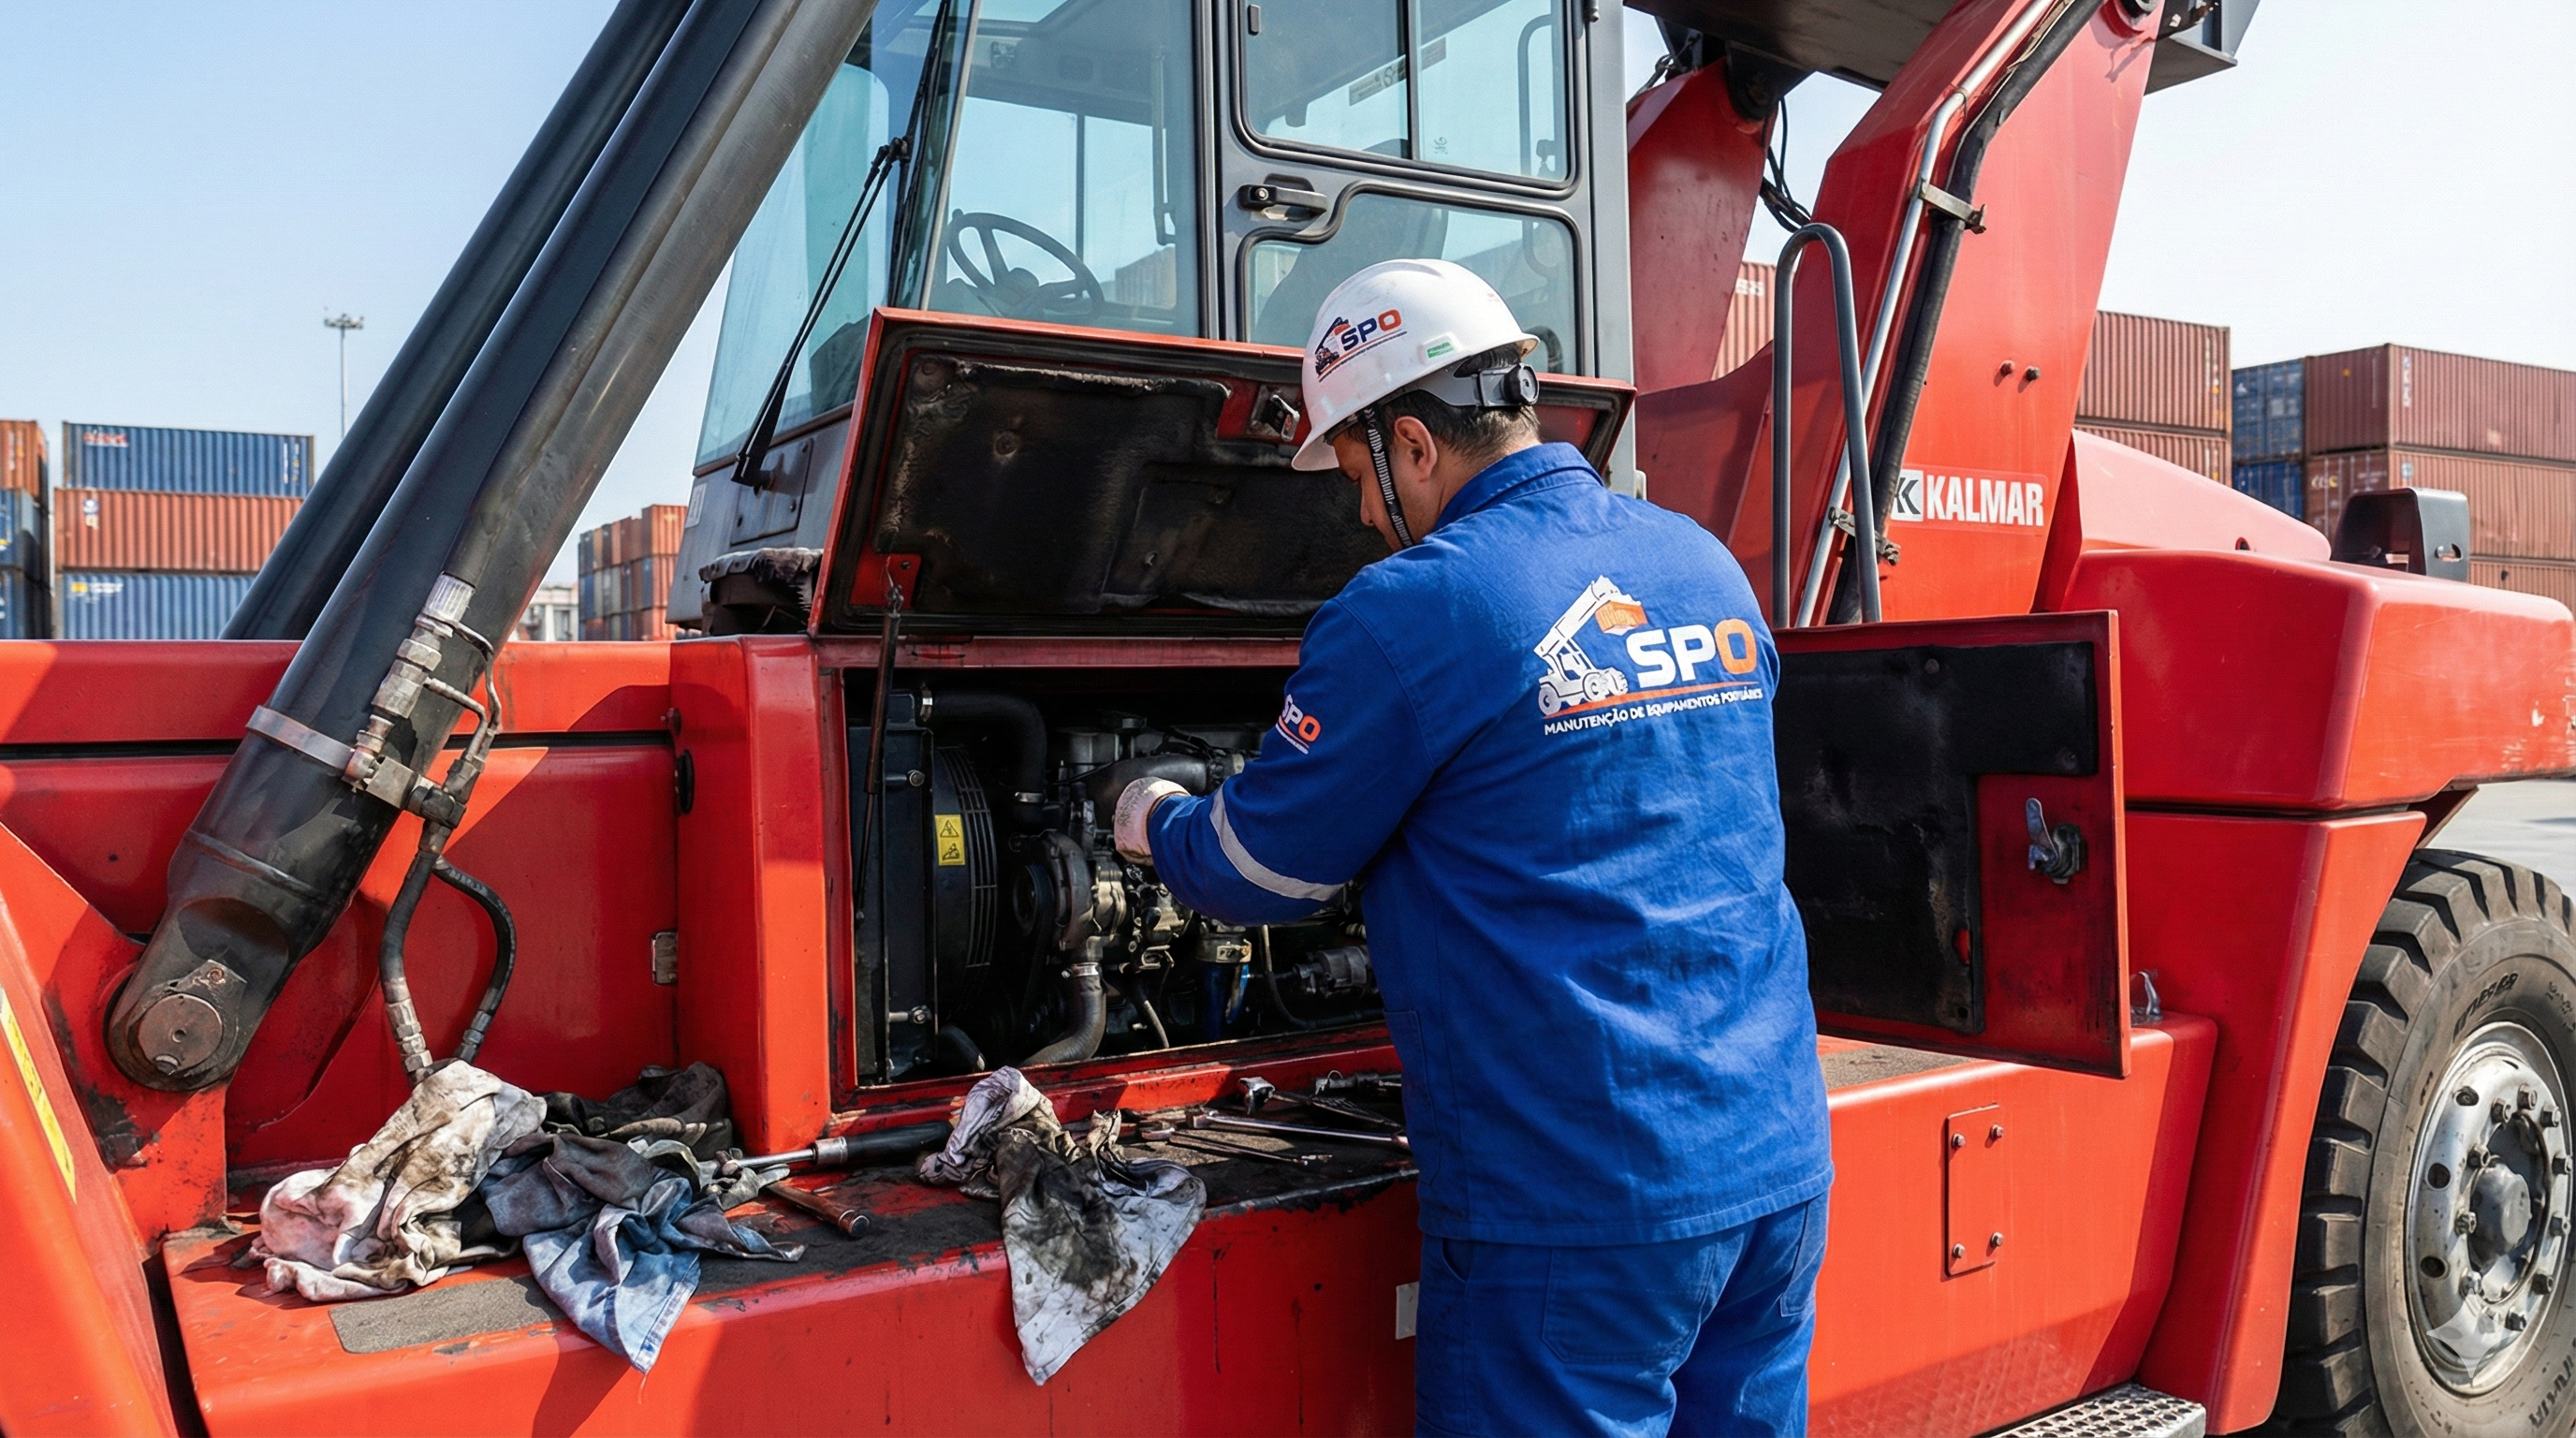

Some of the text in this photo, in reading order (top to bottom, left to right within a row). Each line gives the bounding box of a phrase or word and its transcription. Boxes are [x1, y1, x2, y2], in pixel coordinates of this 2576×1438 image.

[1340, 309, 1402, 351] SPO
[1926, 475, 2044, 527] KALMAR
[1625, 618, 1758, 688] SPO
[1544, 708, 1629, 736] MANUTENÇÃO
[1631, 706, 1644, 719] DE
